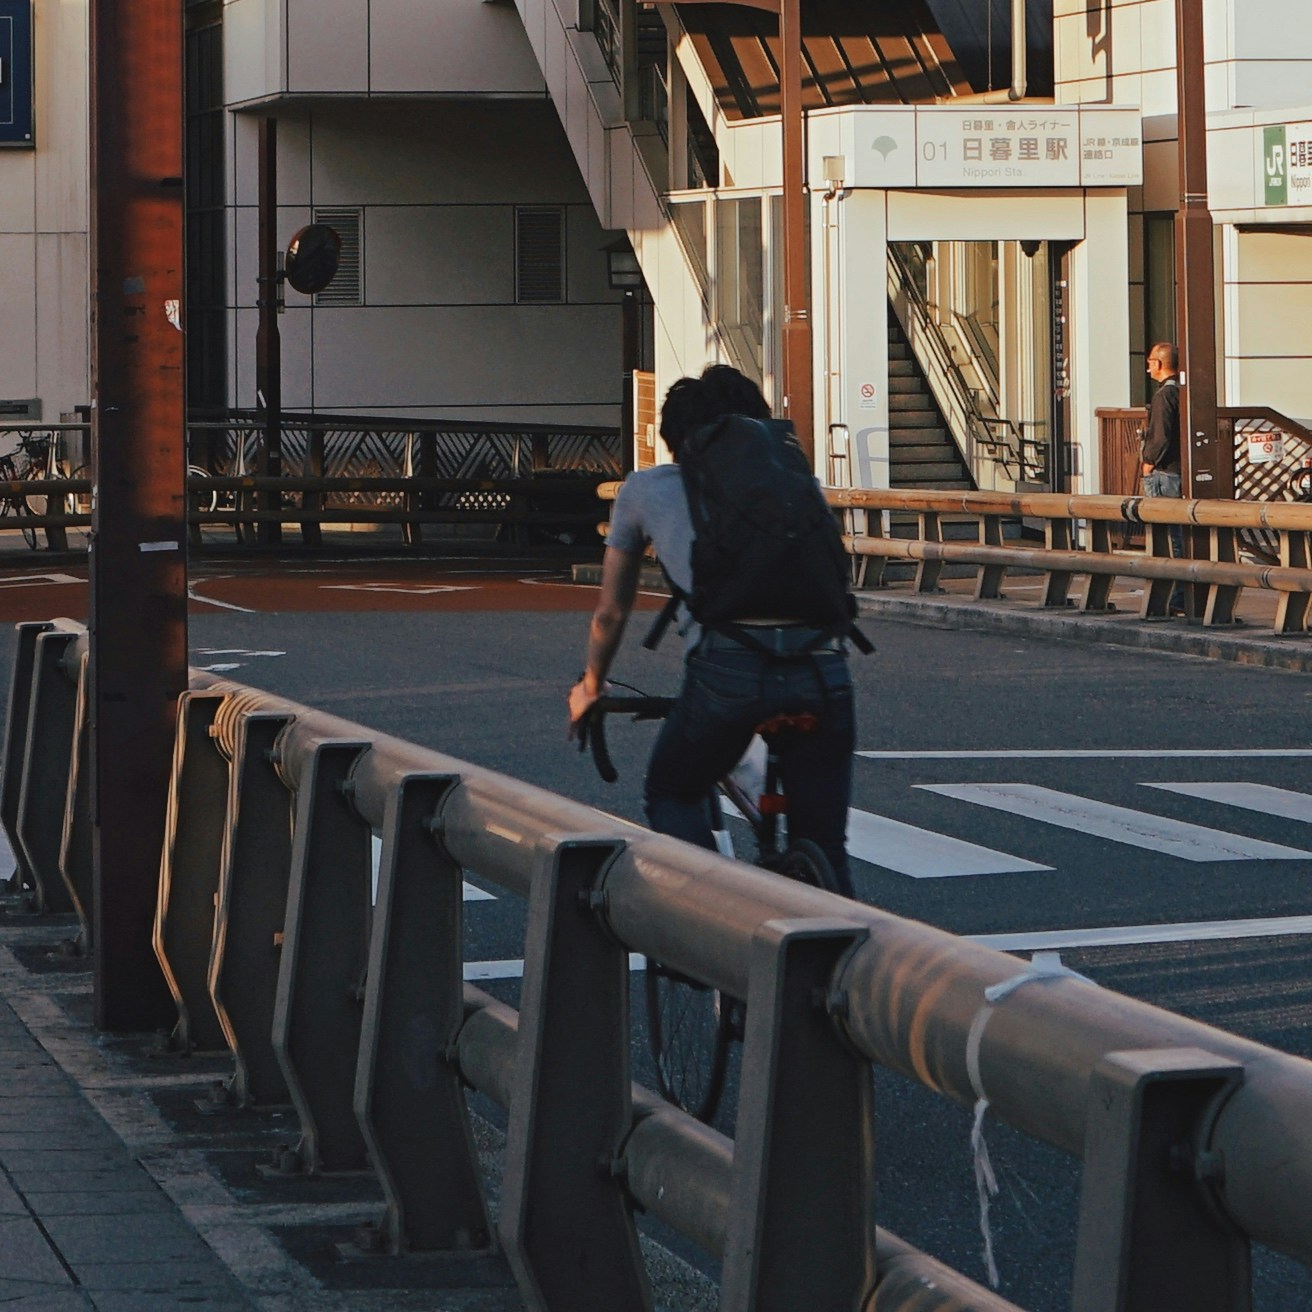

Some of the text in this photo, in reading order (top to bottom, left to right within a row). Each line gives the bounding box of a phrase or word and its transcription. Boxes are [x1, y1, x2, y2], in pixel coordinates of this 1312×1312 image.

[962, 120, 1071, 131] 日暮里・舎人ライナー
[922, 141, 949, 162] 01
[962, 137, 1069, 161] 日暮里駅
[1265, 144, 1284, 175] JR
[962, 167, 1002, 179] Nippori
